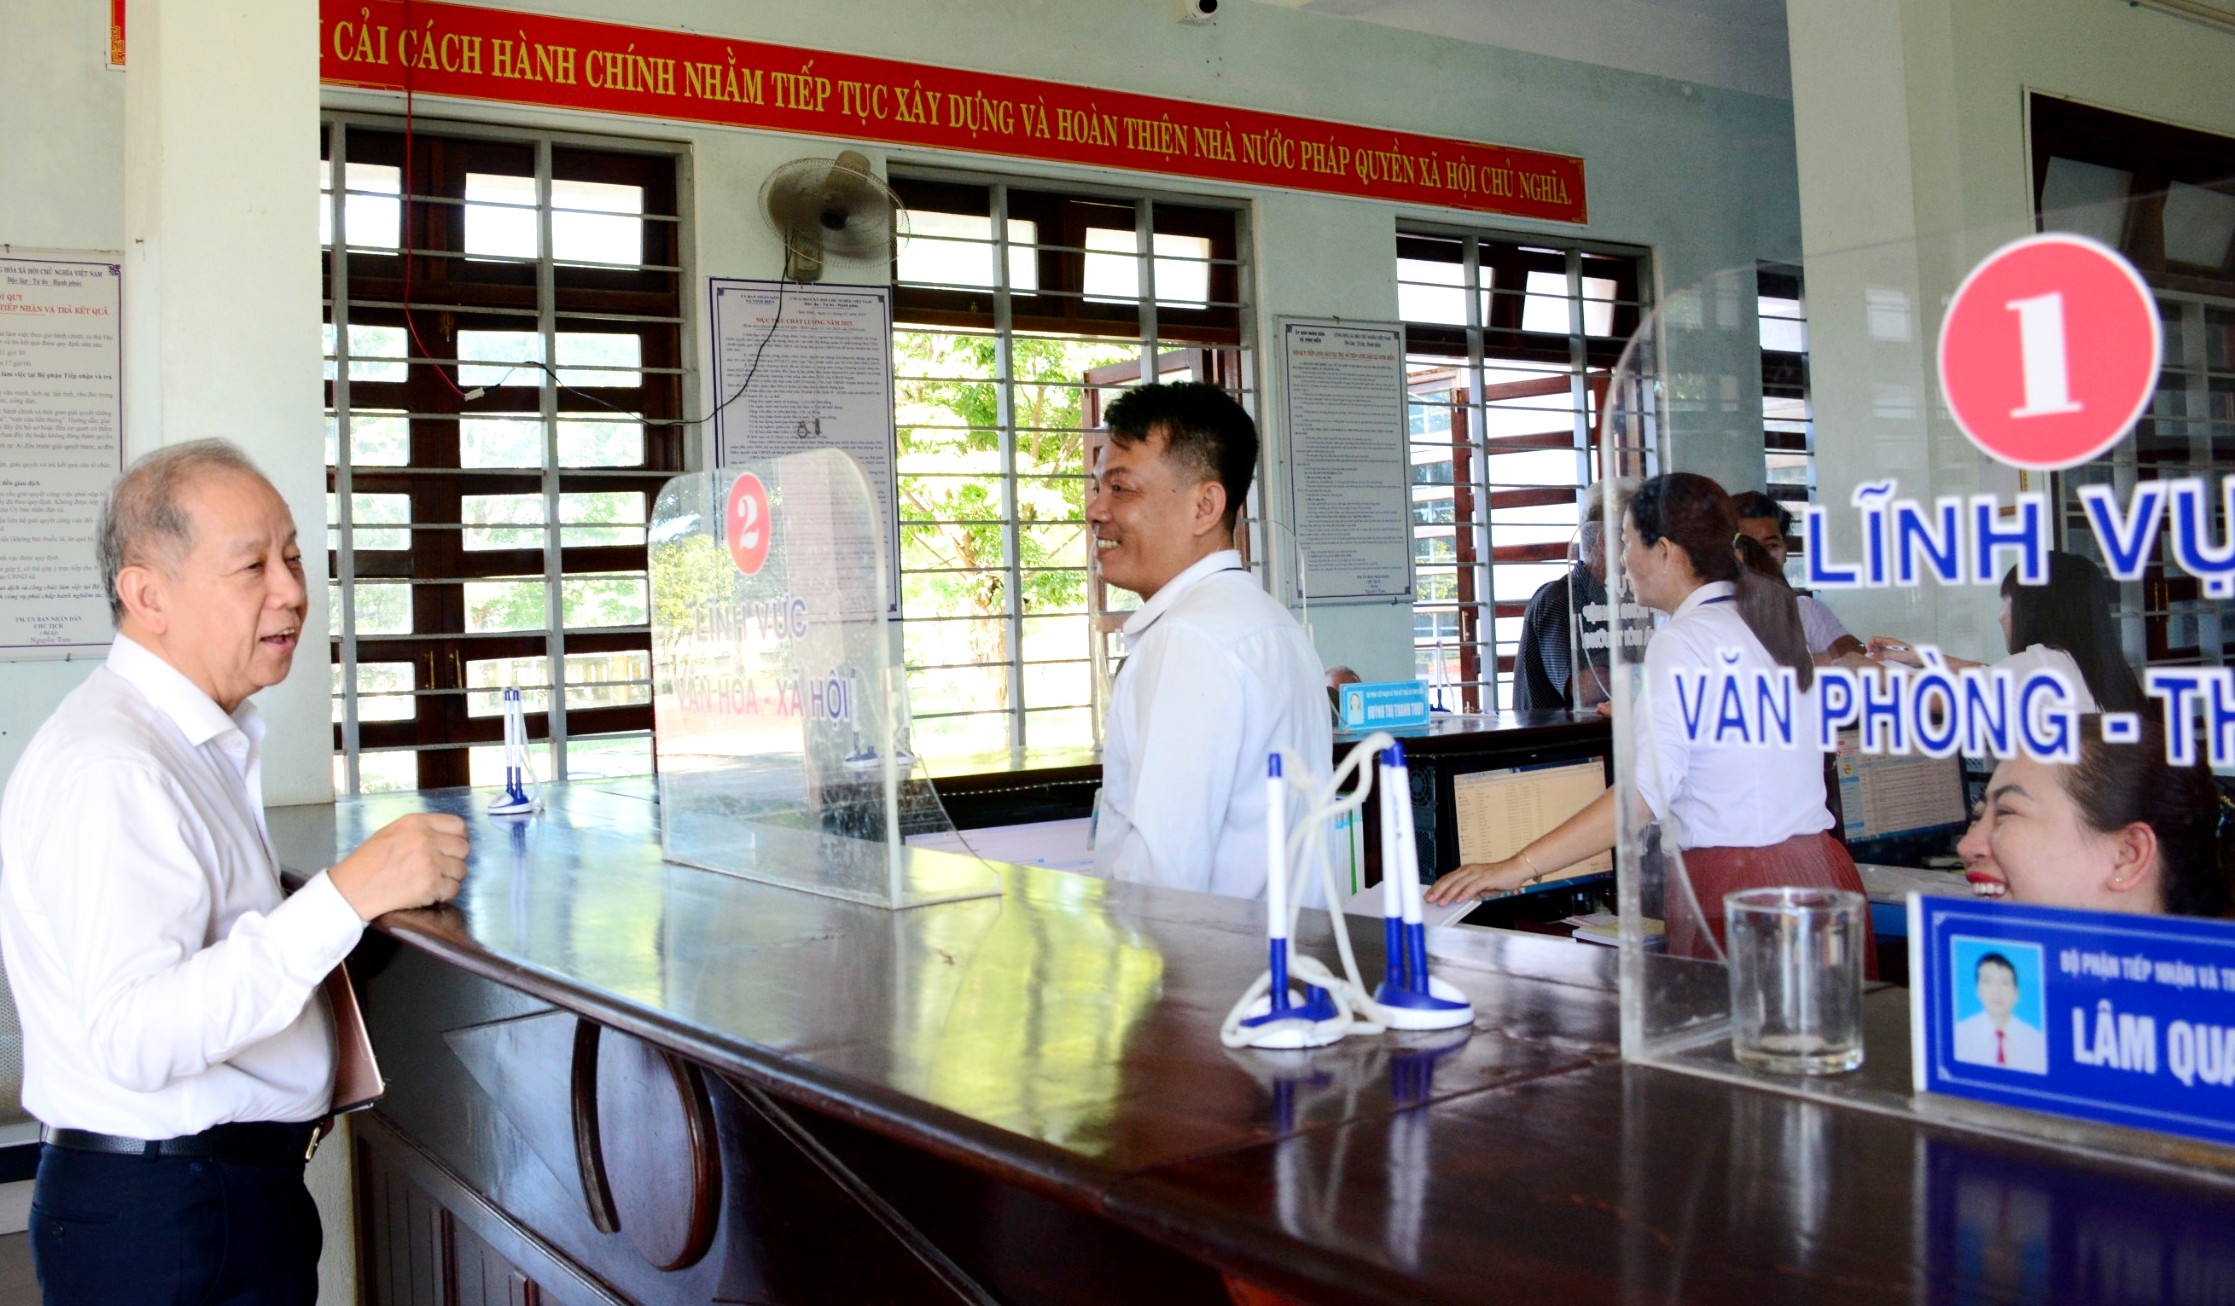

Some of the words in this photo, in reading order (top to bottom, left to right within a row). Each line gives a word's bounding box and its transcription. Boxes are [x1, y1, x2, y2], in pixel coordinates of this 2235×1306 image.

[333, 6, 389, 65] CẢI
[398, 18, 483, 75] CÁCH
[491, 29, 577, 85] HÀNH
[585, 42, 676, 96] CHÍNH
[683, 46, 765, 105] NHẰM
[770, 58, 831, 112] TIẾP
[837, 80, 889, 126] TỤC
[894, 79, 942, 126] XÂY
[947, 89, 1015, 139] DỰNG
[1019, 95, 1050, 139] VÀ
[1056, 102, 1118, 148] HOÀN
[1123, 112, 1189, 162] THIỆN
[1193, 120, 1237, 162] NHÀ
[1241, 127, 1296, 169] NƯỚC
[1300, 135, 1350, 176] PHÁP
[1355, 137, 1415, 185] QUYỀN
[1418, 151, 1442, 188] XÃ
[1446, 155, 1477, 199] HỘI
[1480, 157, 1514, 198] CHỦ
[2003, 289, 2086, 420] 1
[736, 494, 761, 551] 2
[1806, 480, 2049, 589] LĨNH
[695, 598, 747, 642] LĨNH
[755, 595, 807, 647] VỰC
[776, 668, 804, 717] XÃ
[810, 668, 849, 729] HỘI
[1674, 650, 1794, 748] VĂN
[1818, 649, 2071, 759] PHÒNG
[2060, 946, 2080, 979] BỘ
[2081, 950, 2120, 981] PHẬN
[2121, 951, 2153, 982] TIẾP
[2154, 958, 2196, 991] NHẬN
[2198, 963, 2219, 990] VÀ
[2072, 998, 2157, 1075] LÂM
